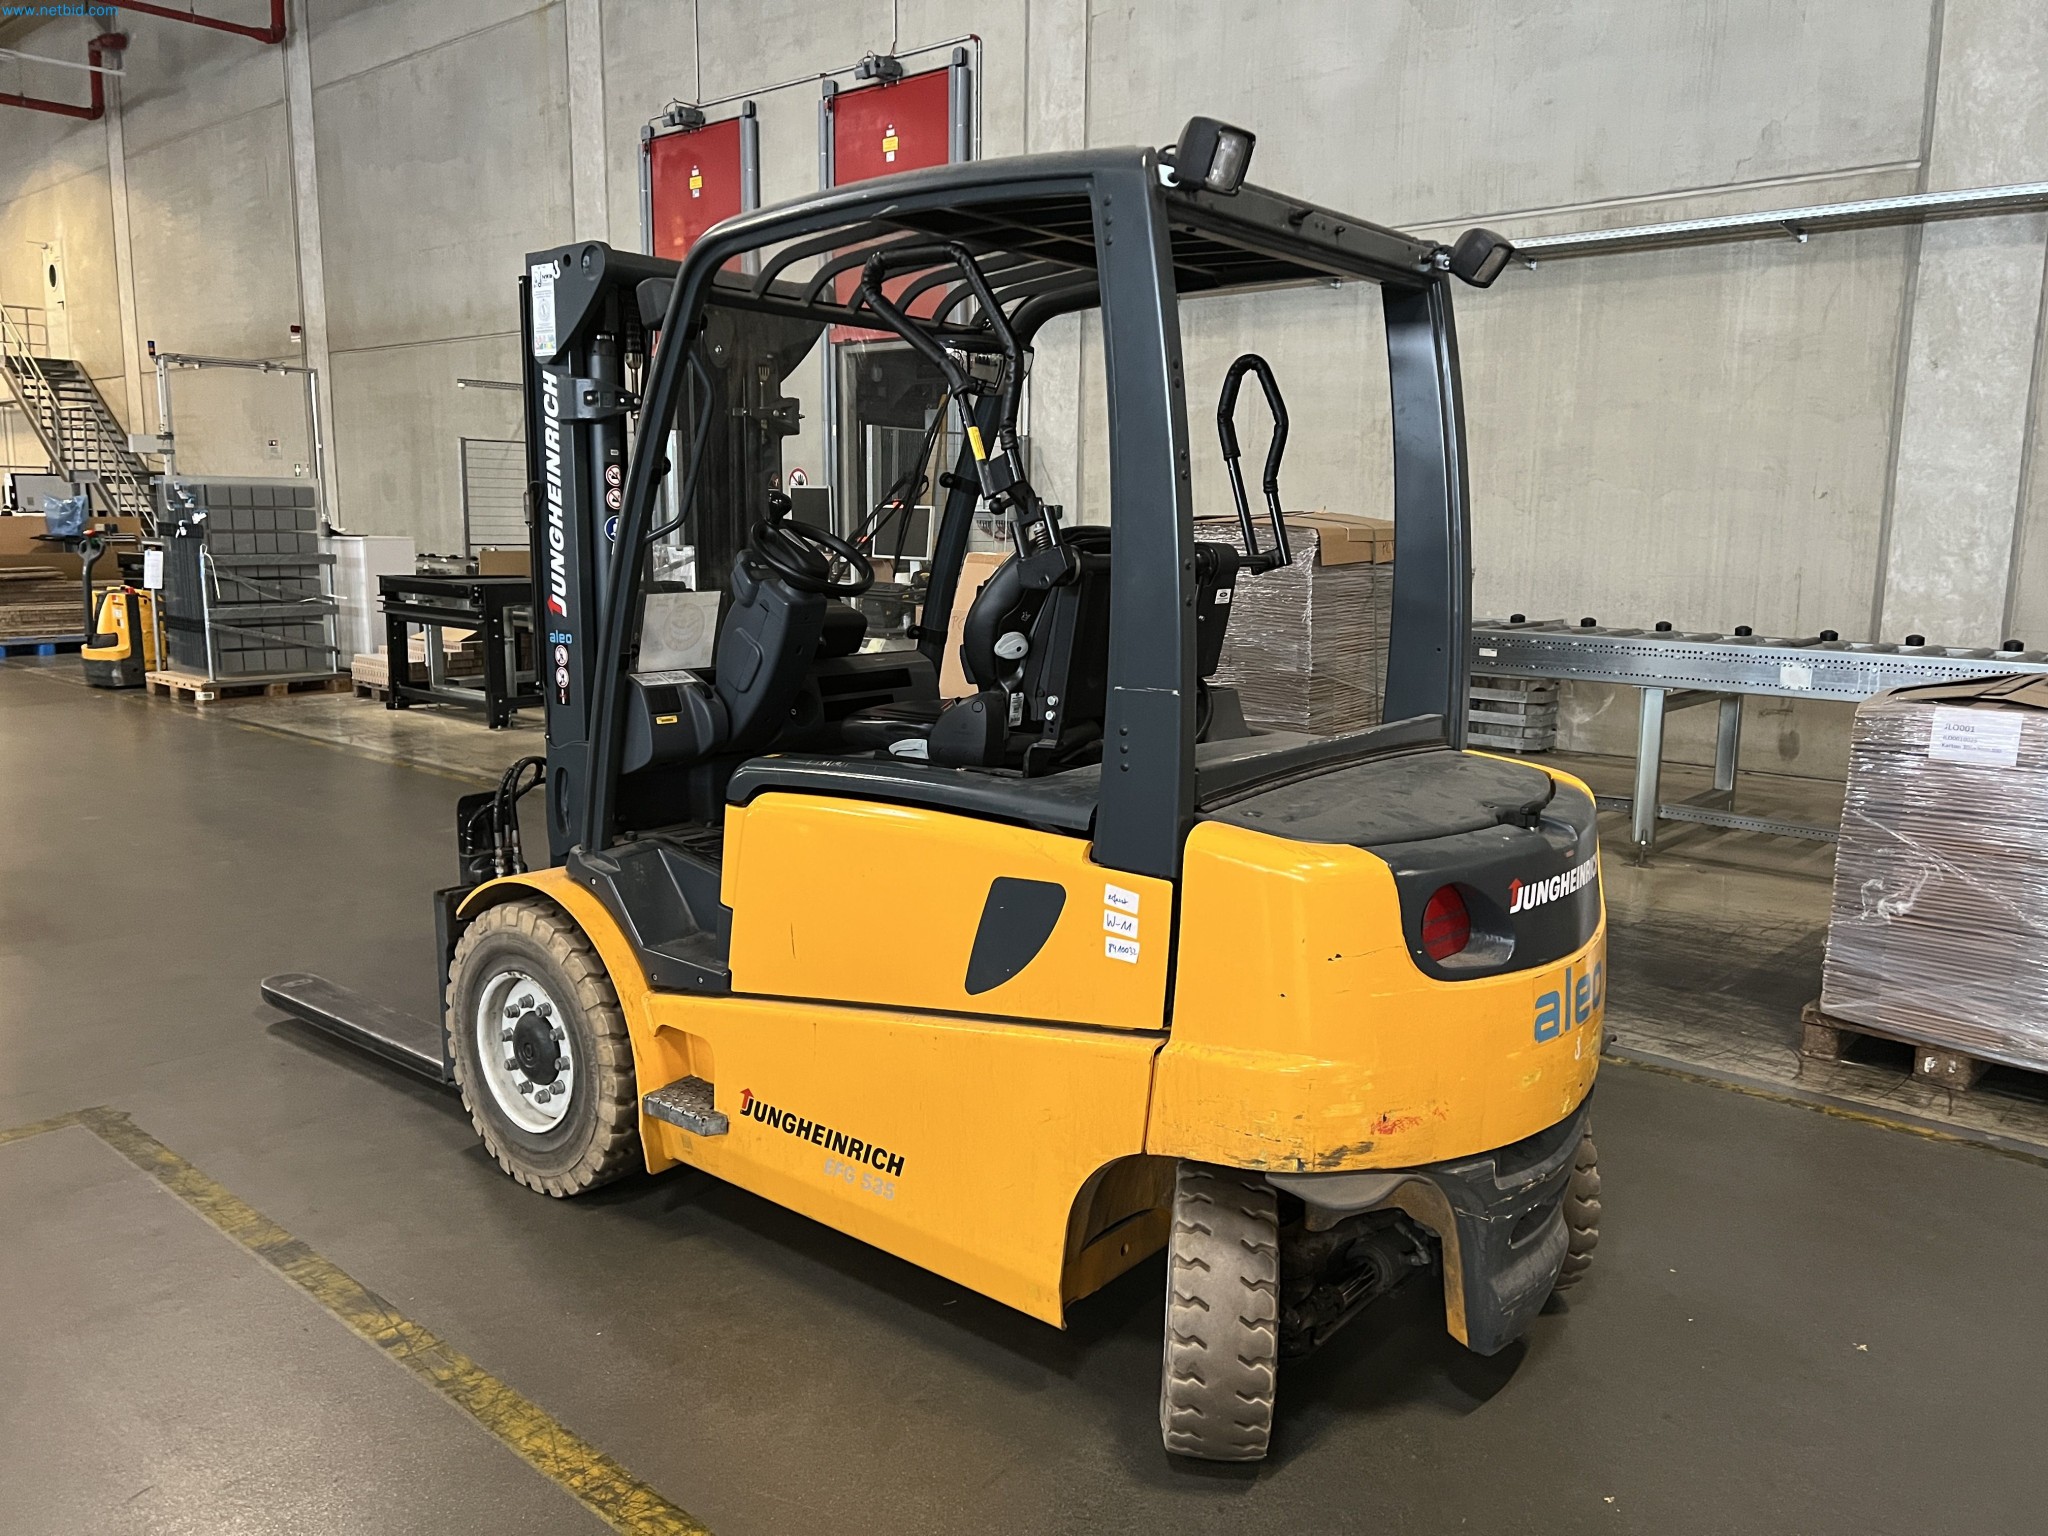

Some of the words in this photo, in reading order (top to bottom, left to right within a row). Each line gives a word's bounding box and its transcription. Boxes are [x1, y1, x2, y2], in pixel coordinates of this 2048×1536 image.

[542, 370, 568, 618] JUNGHEINRICH
[549, 629, 573, 644] aleo
[1534, 960, 1602, 1043] aleo
[739, 1096, 905, 1177] JUNGHEINRICH
[823, 1157, 856, 1184] EFG
[860, 1171, 895, 1200] 535
